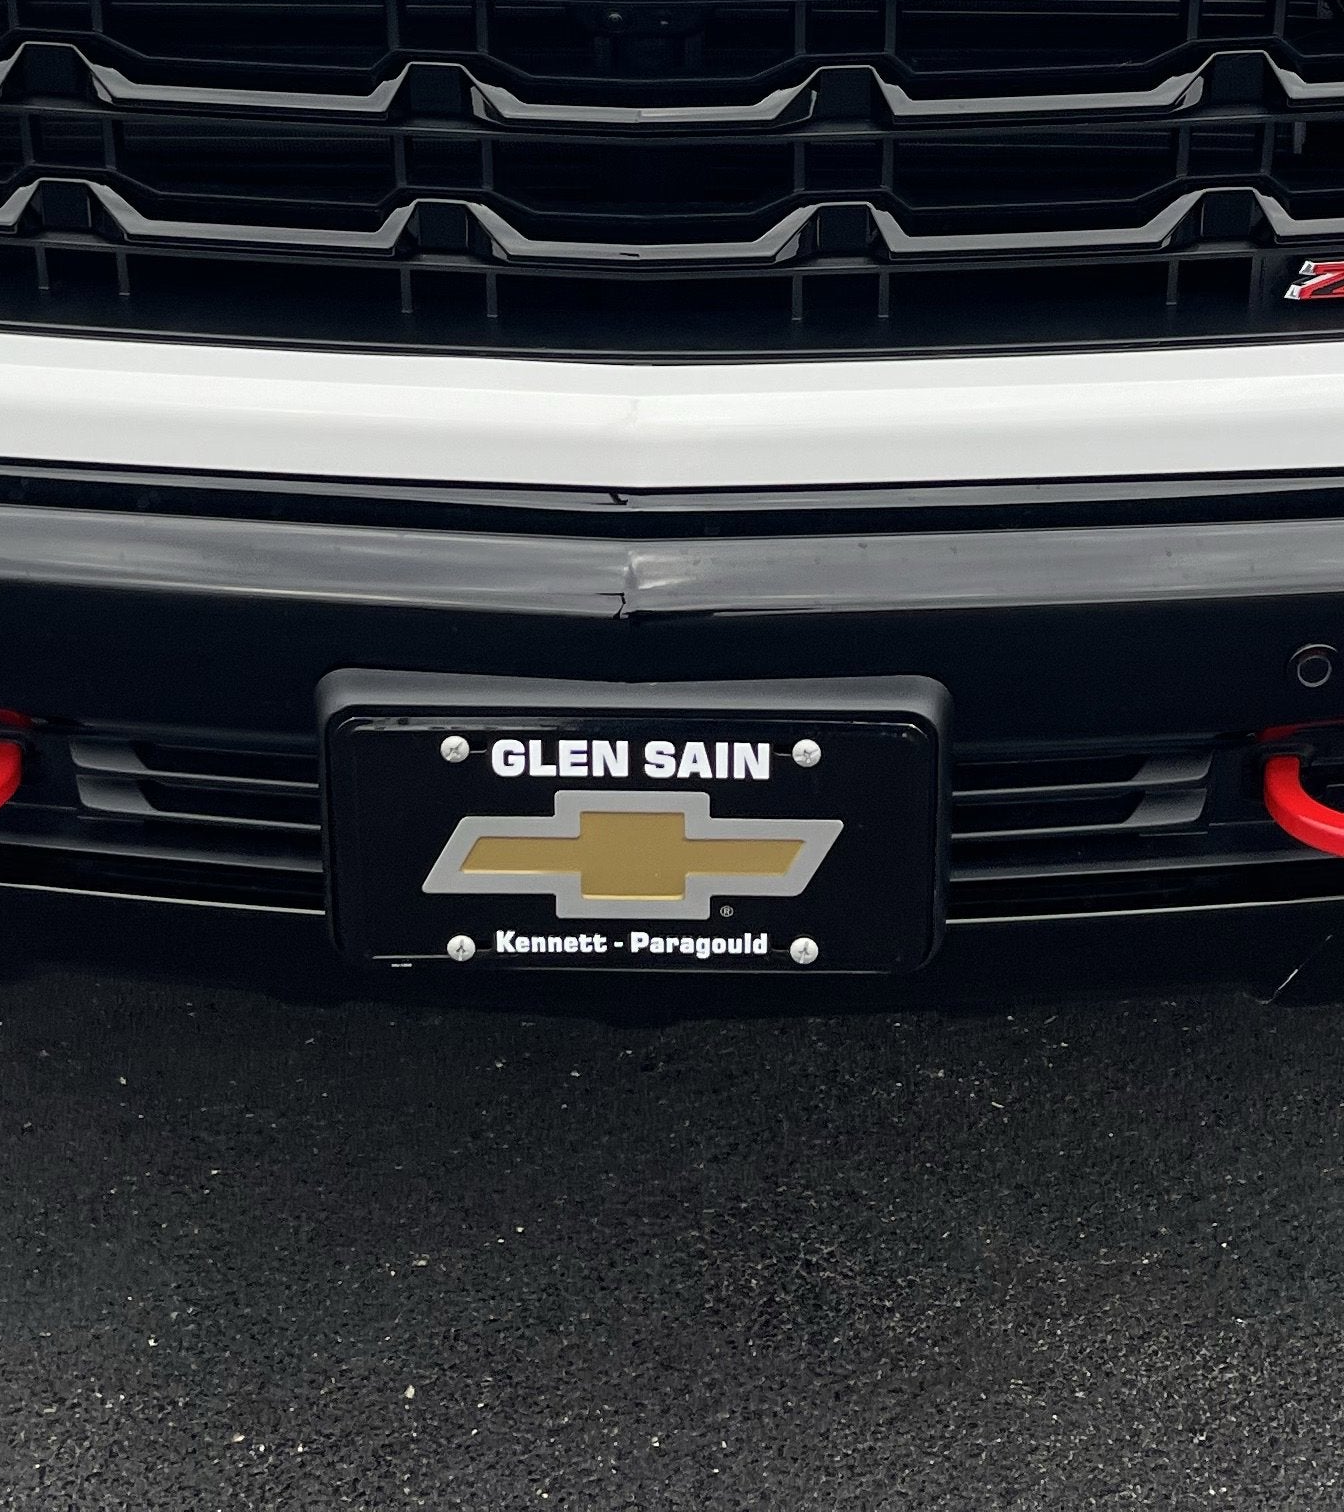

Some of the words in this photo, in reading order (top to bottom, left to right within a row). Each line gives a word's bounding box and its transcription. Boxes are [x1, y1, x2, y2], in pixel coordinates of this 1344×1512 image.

[491, 739, 629, 777] GLEN
[644, 740, 771, 780] SAIN
[496, 930, 608, 954] Kennett
[630, 931, 769, 959] Paragould
